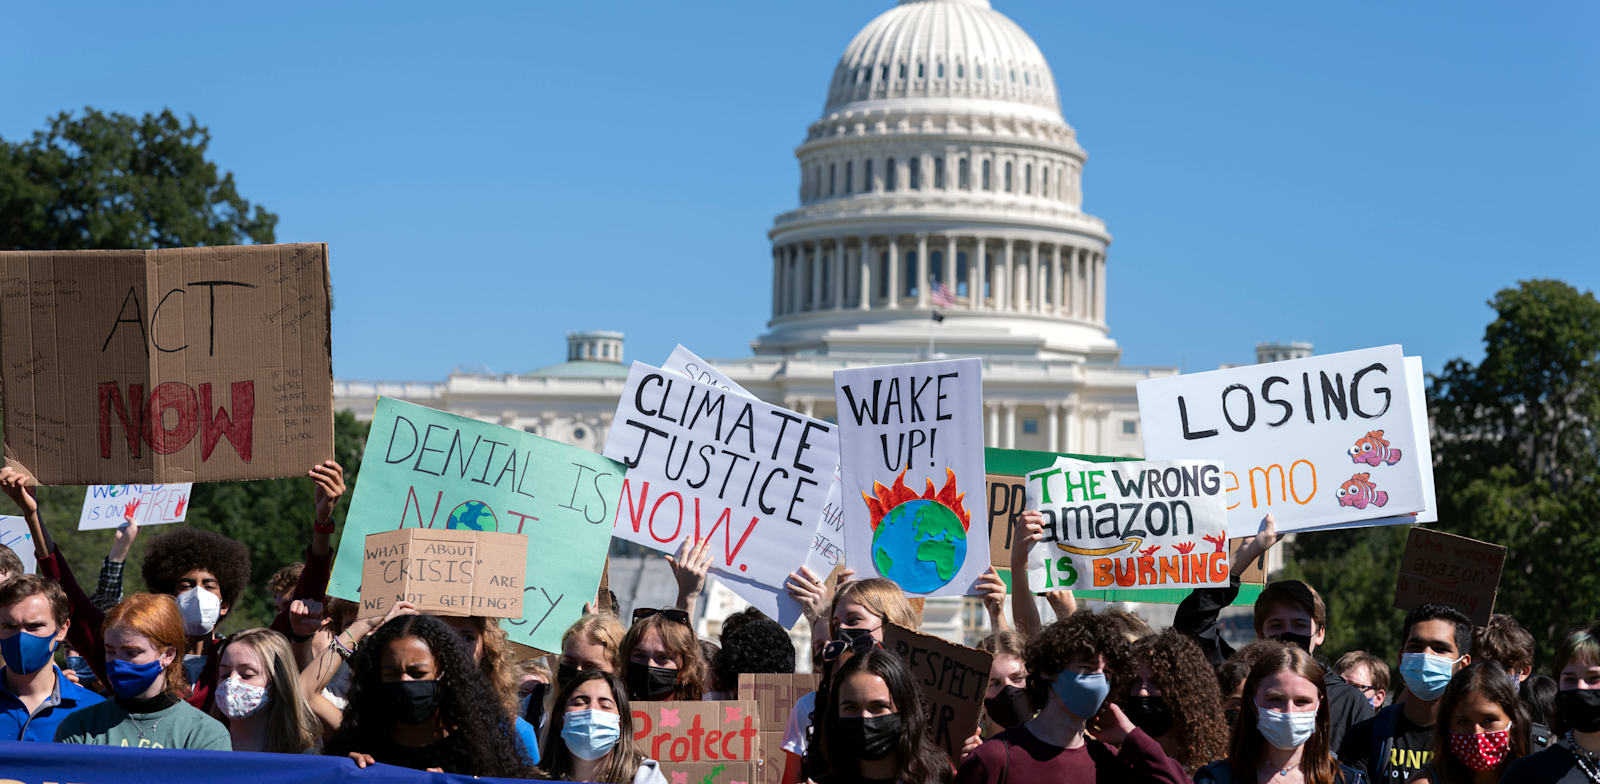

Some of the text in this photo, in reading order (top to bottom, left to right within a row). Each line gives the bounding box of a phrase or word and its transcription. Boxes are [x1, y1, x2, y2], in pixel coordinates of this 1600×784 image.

[102, 280, 258, 358] ACT
[98, 380, 255, 463] NOW
[634, 373, 830, 474] CLIMATE
[841, 372, 959, 426] WAKE
[1177, 362, 1391, 440] LOSING
[385, 415, 613, 525] DENIAL IS
[624, 419, 818, 526] JUSTICE
[879, 428, 937, 472] UP!
[88, 489, 184, 522] IS ON FIRE
[1029, 464, 1220, 504] THE WRONG
[1224, 458, 1317, 510] emo
[613, 479, 760, 572] NOW.
[1040, 500, 1194, 542] amazon
[366, 543, 475, 560] WHAT ABOUT
[379, 558, 519, 588] "CRISIS" ARE
[1044, 551, 1229, 588] IS BURNING
[1413, 557, 1486, 584] amazon
[364, 593, 519, 610] WE NOT GETTING?
[631, 710, 757, 762] Protect
